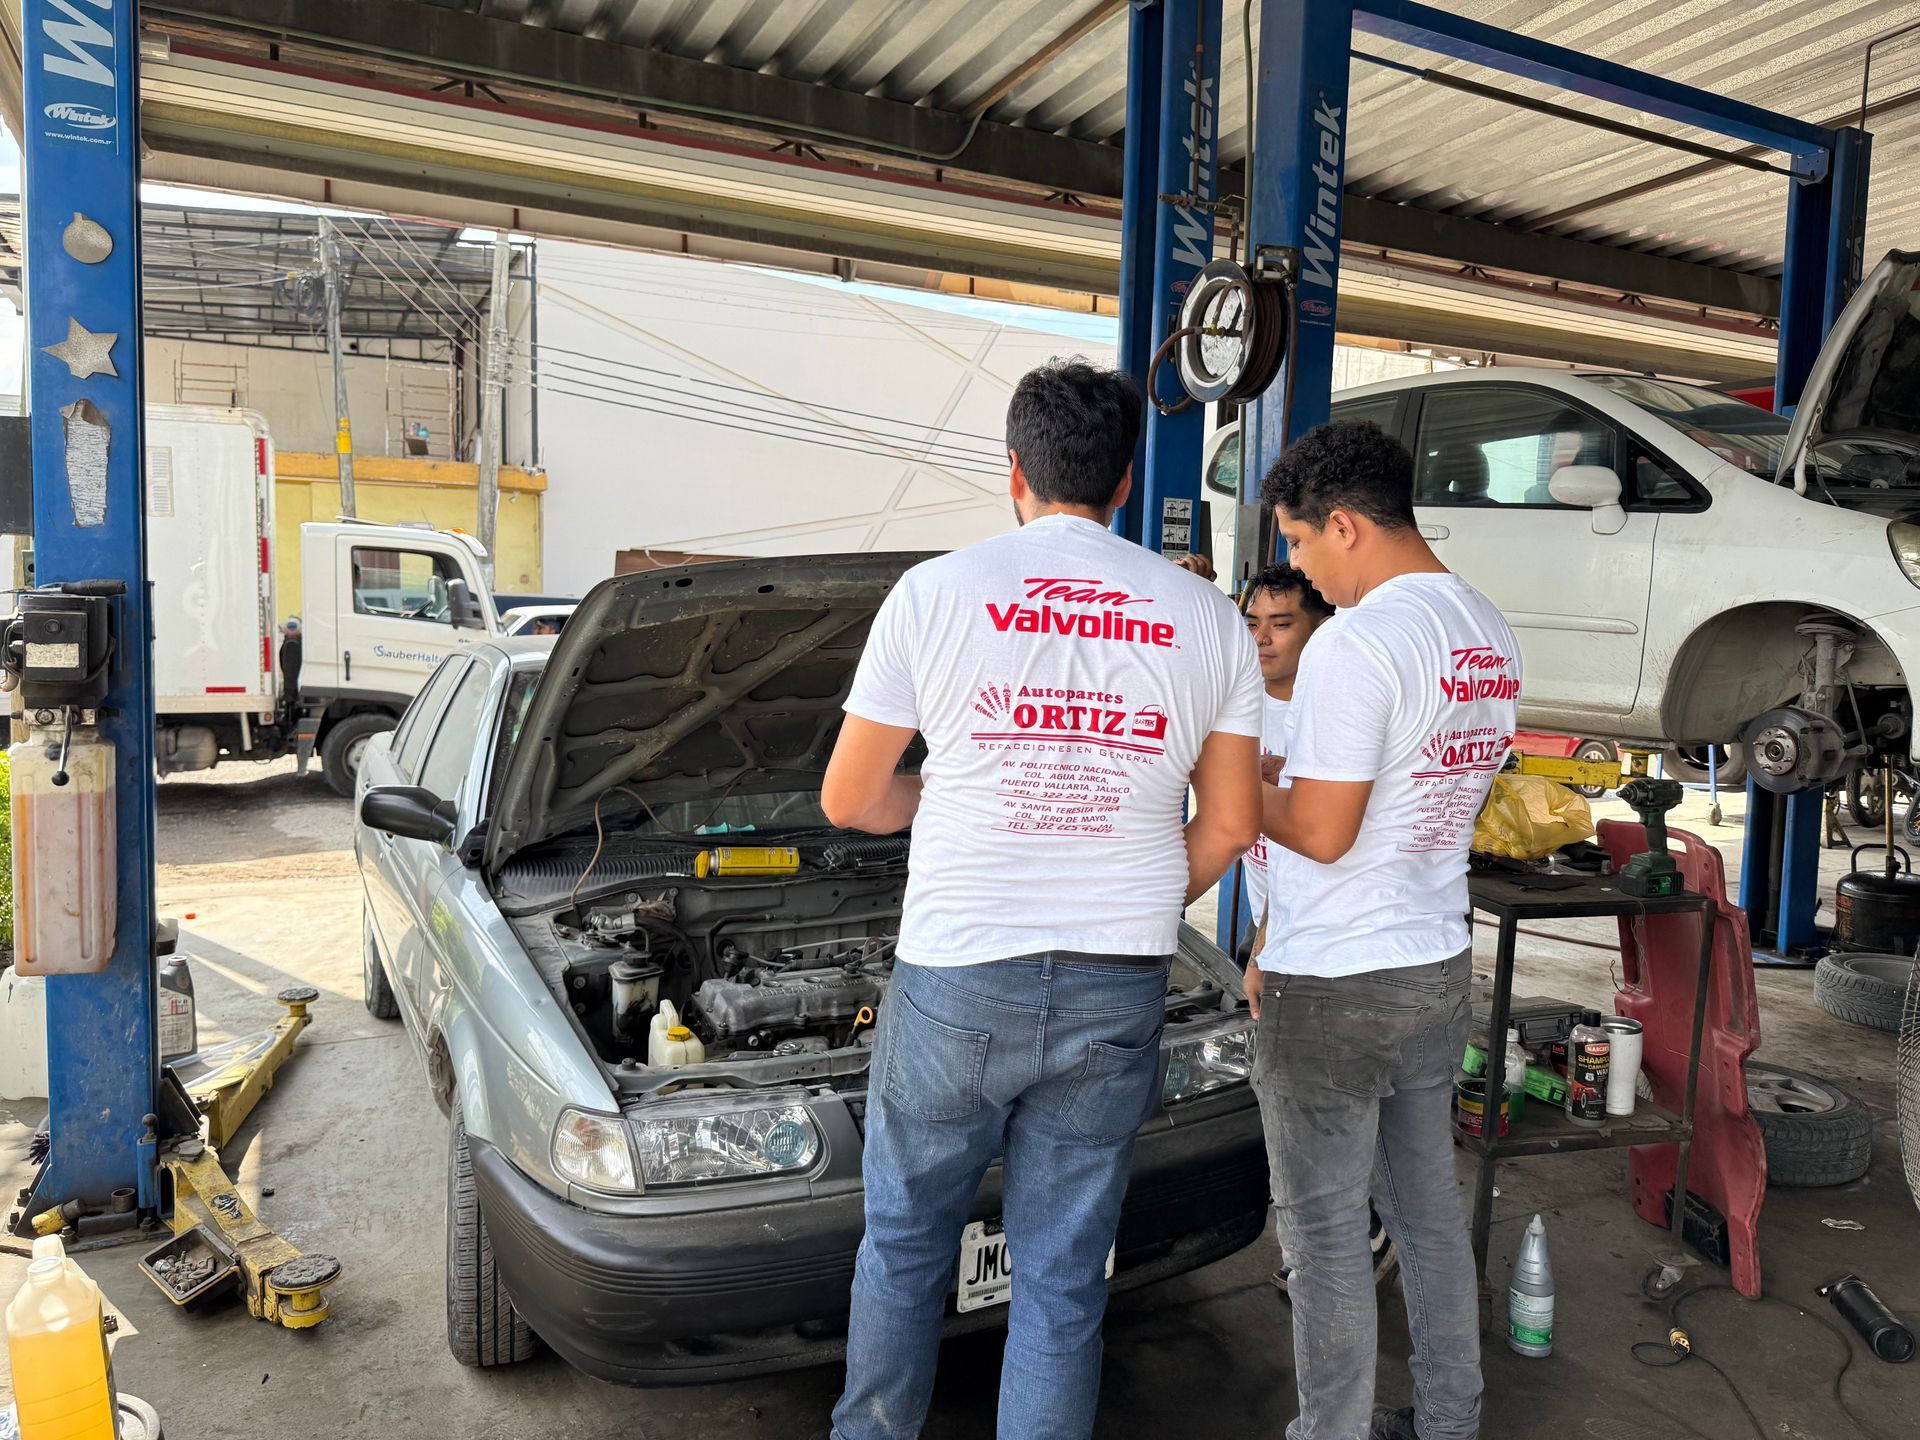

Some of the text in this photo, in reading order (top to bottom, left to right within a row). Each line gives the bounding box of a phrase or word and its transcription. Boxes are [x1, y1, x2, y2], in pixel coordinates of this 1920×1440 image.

[50, 105, 113, 126] Wintek
[1302, 100, 1341, 288] Wintek
[1024, 578, 1154, 606] Team
[986, 603, 1174, 648] Valvoline
[1451, 647, 1512, 671] Team
[1017, 686, 1124, 704] Autopartes
[1014, 704, 1126, 736] ORTIZ
[978, 743, 1154, 765] REFACCIONES EN GENERAL
[1441, 741, 1496, 767] ORTIZ
[1019, 761, 1080, 771] POLITECNICO
[1001, 779, 1040, 788] PUERTO
[1095, 786, 1130, 794] JALISCO
[1024, 771, 1044, 779] COL.
[1078, 775, 1109, 784] ZARCA,
[1020, 802, 1052, 812] SANTA
[1056, 806, 1093, 814] TERESITA
[1091, 796, 1120, 804] 3789
[1015, 811, 1035, 820] COL.
[1007, 821, 1030, 830] TEL:
[1034, 822, 1054, 830] 322
